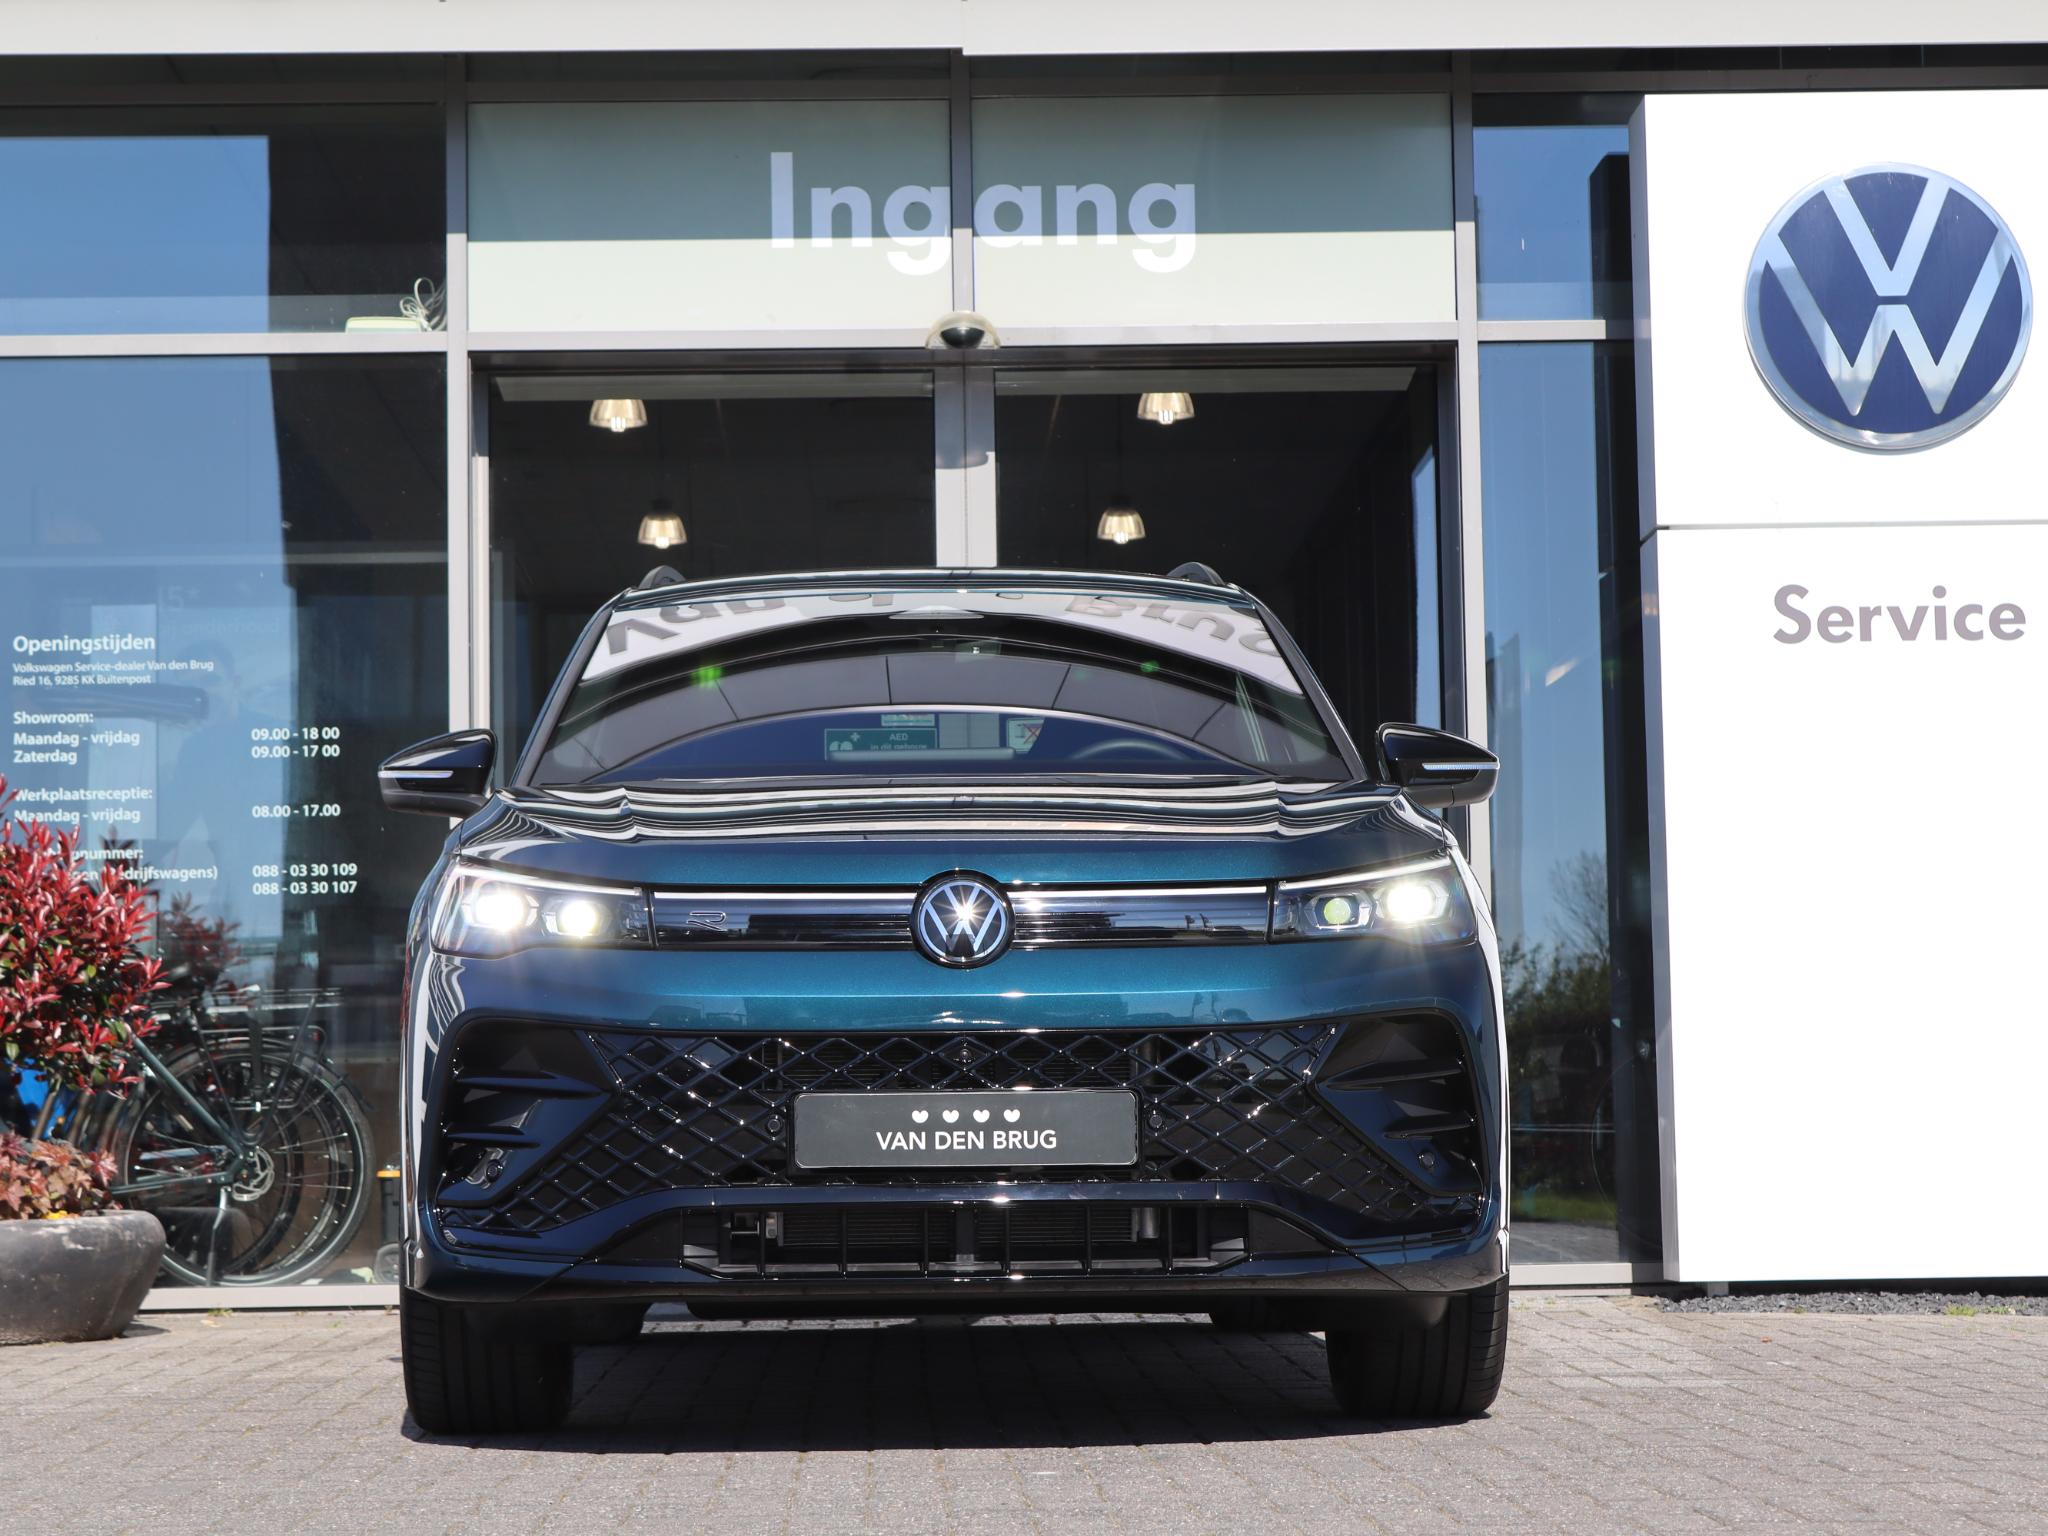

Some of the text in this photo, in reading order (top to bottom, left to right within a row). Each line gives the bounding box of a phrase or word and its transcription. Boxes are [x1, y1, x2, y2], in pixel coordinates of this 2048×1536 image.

[770, 152, 1197, 276] Ingang
[1772, 583, 2027, 645] Service
[12, 633, 156, 656] Openingstijden
[12, 659, 214, 675] Volkswagen Service-dealer Van den Brug
[12, 675, 36, 686] Ried
[55, 675, 80, 686] 9285
[82, 674, 95, 685] KK
[97, 673, 151, 686] Buitenpost
[13, 711, 94, 725] Showroom:
[13, 731, 80, 747] Maandag
[90, 730, 141, 747] vrijdag
[251, 728, 290, 741] 09.00
[889, 732, 909, 741] AED
[13, 749, 78, 765] Zaterdag
[251, 745, 290, 758] 09.00
[15, 786, 153, 804] Werkplaatsreceptie:
[14, 808, 80, 824] Maandag
[90, 807, 141, 824] vrijdag
[251, 805, 291, 818] 08.00
[302, 803, 341, 817] 17.00
[252, 864, 279, 877] 088
[289, 863, 308, 876] 03
[310, 863, 329, 876] 30
[331, 862, 358, 875] 109
[252, 882, 279, 895] 088
[289, 881, 308, 894] 03
[310, 881, 329, 894] 30
[331, 880, 358, 893] 107
[876, 1129, 1058, 1151] VAN DEN BRUG
